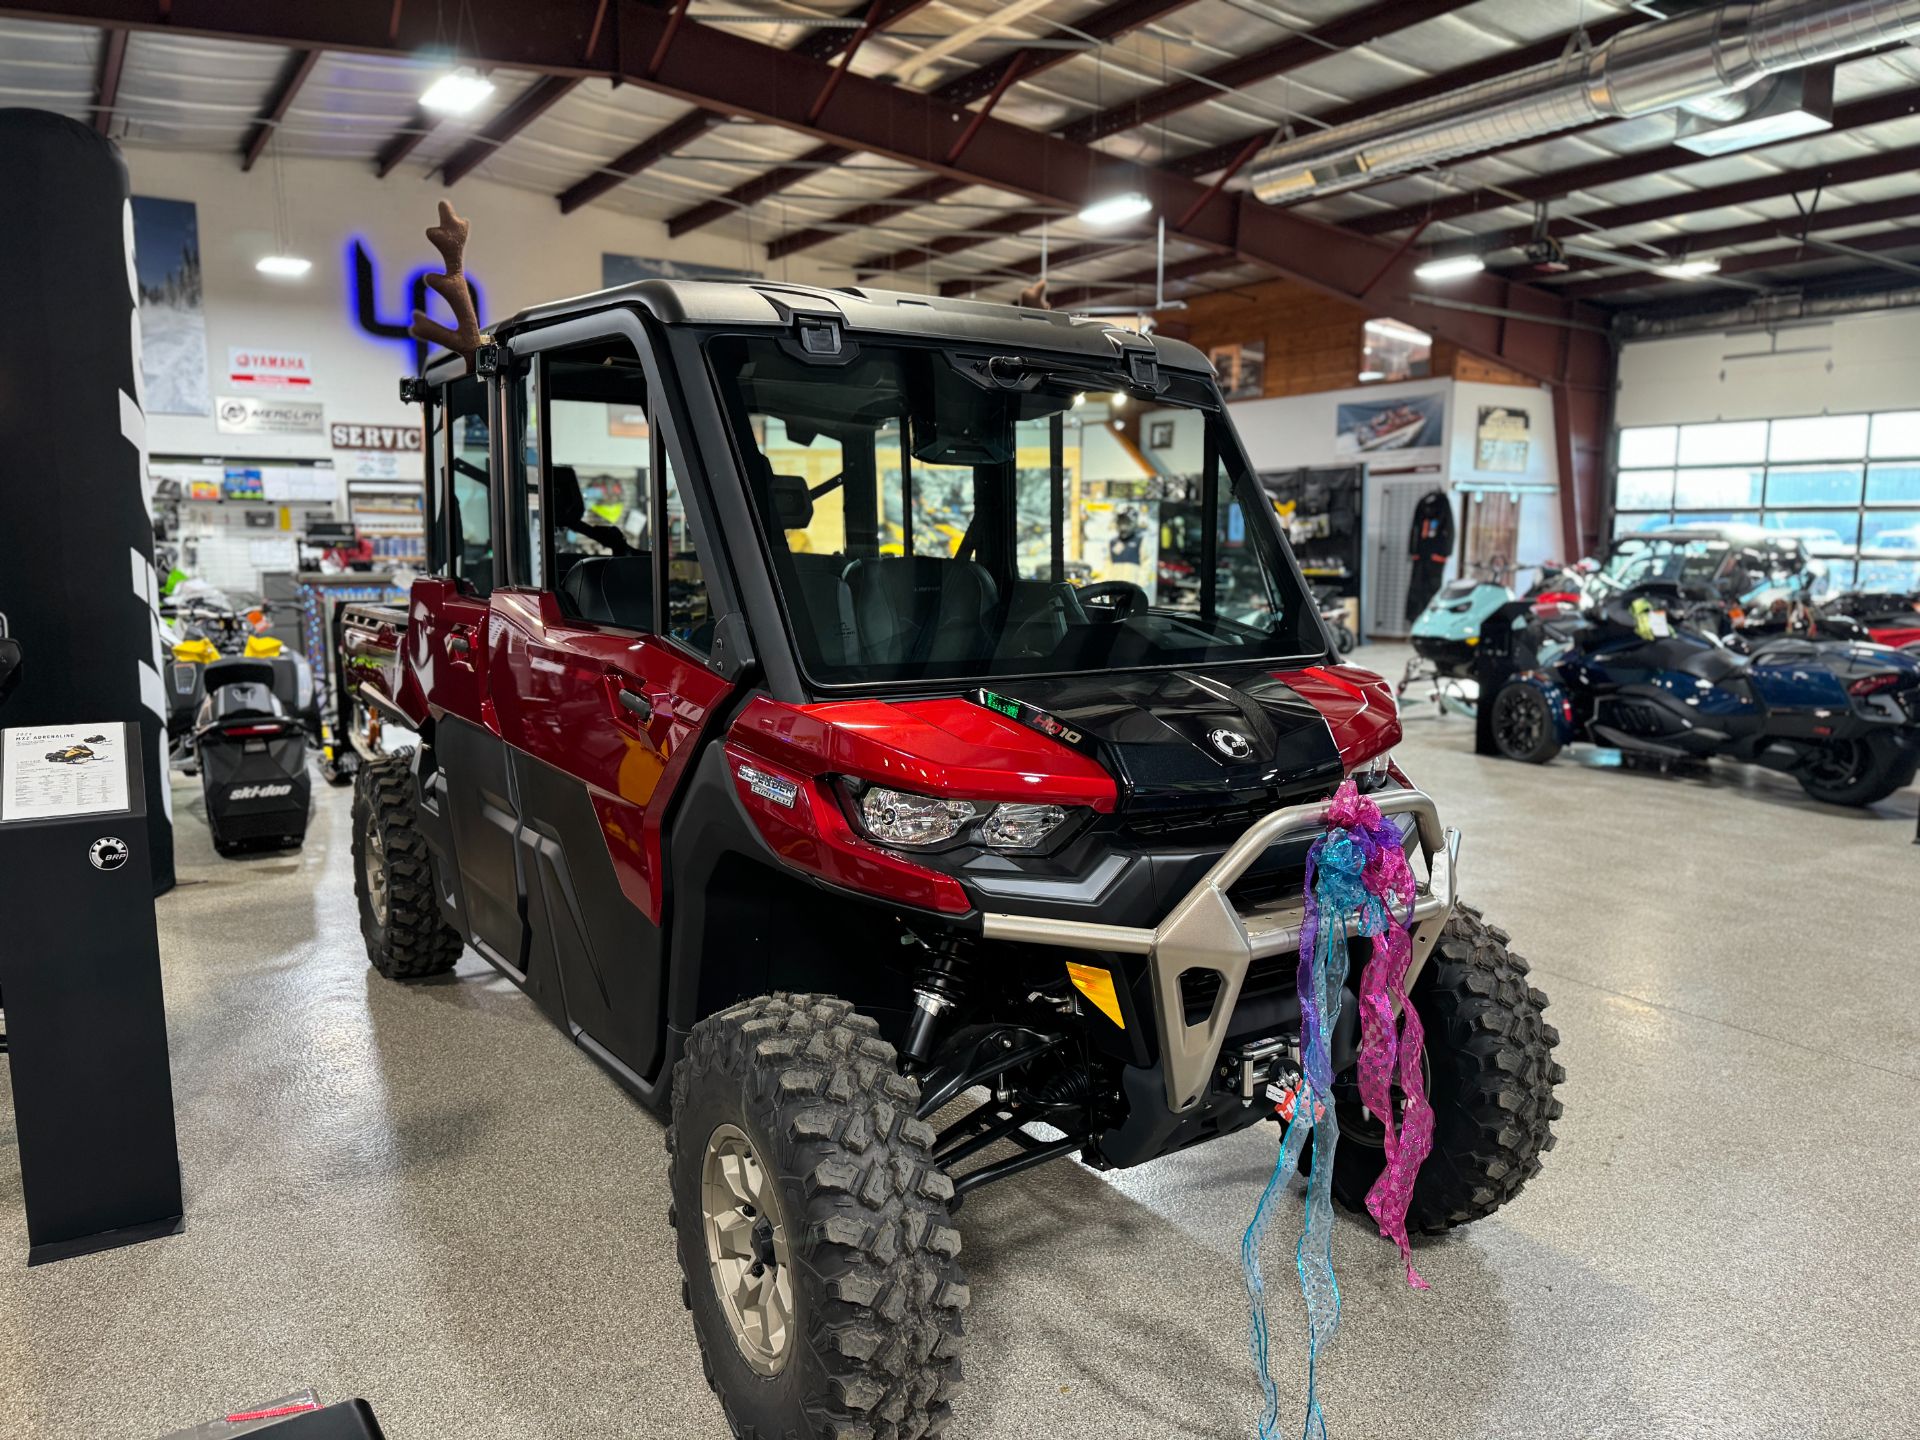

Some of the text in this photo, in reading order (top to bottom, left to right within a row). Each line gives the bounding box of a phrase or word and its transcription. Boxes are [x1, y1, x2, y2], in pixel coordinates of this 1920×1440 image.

[252, 354, 305, 370] YAMAHA
[251, 408, 322, 421] MERCURY
[332, 427, 421, 448] SERVIC
[1032, 714, 1082, 744] HD10
[229, 784, 293, 800] ski-doo
[105, 853, 127, 861] BRP
